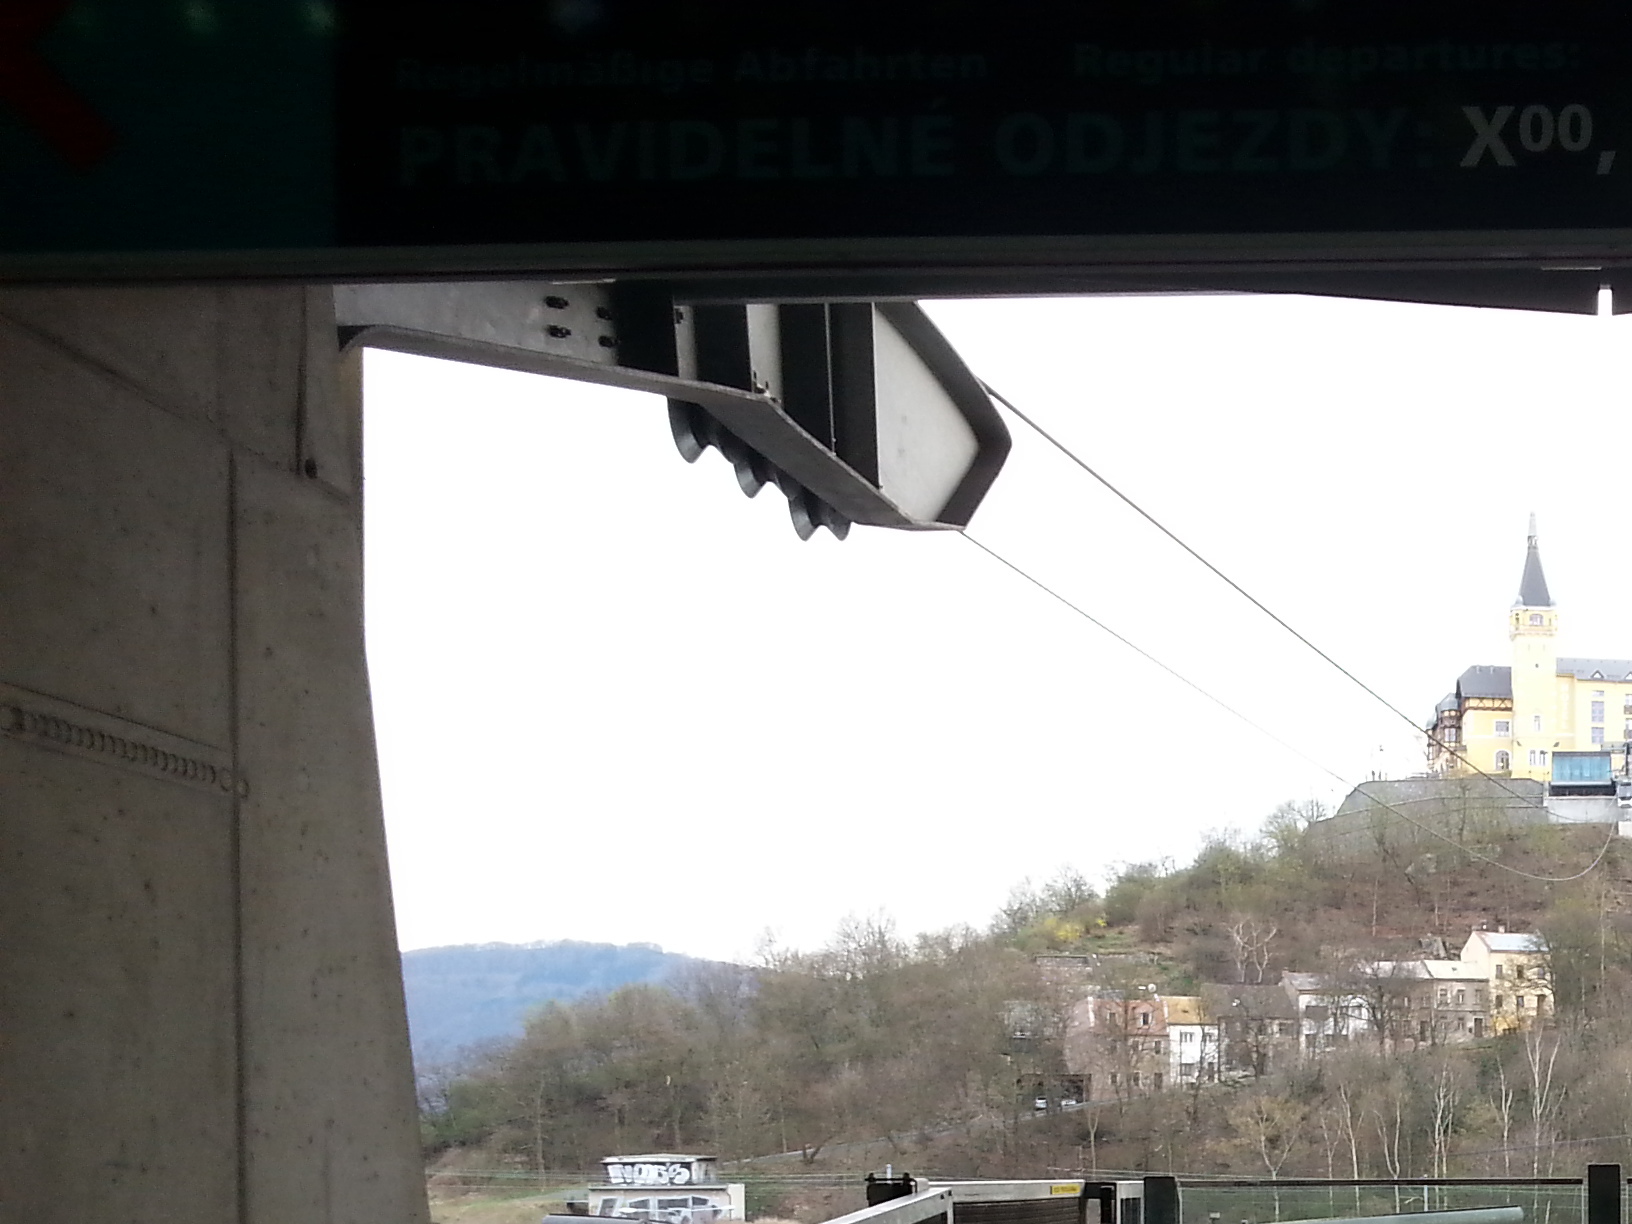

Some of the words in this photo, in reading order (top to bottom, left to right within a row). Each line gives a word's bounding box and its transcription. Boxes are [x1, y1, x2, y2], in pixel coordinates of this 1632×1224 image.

[735, 46, 990, 84] Abfahrten
[1071, 41, 1261, 85] Regular
[1286, 36, 1582, 82] departures:
[395, 99, 956, 187] PRAVIDELNÉ
